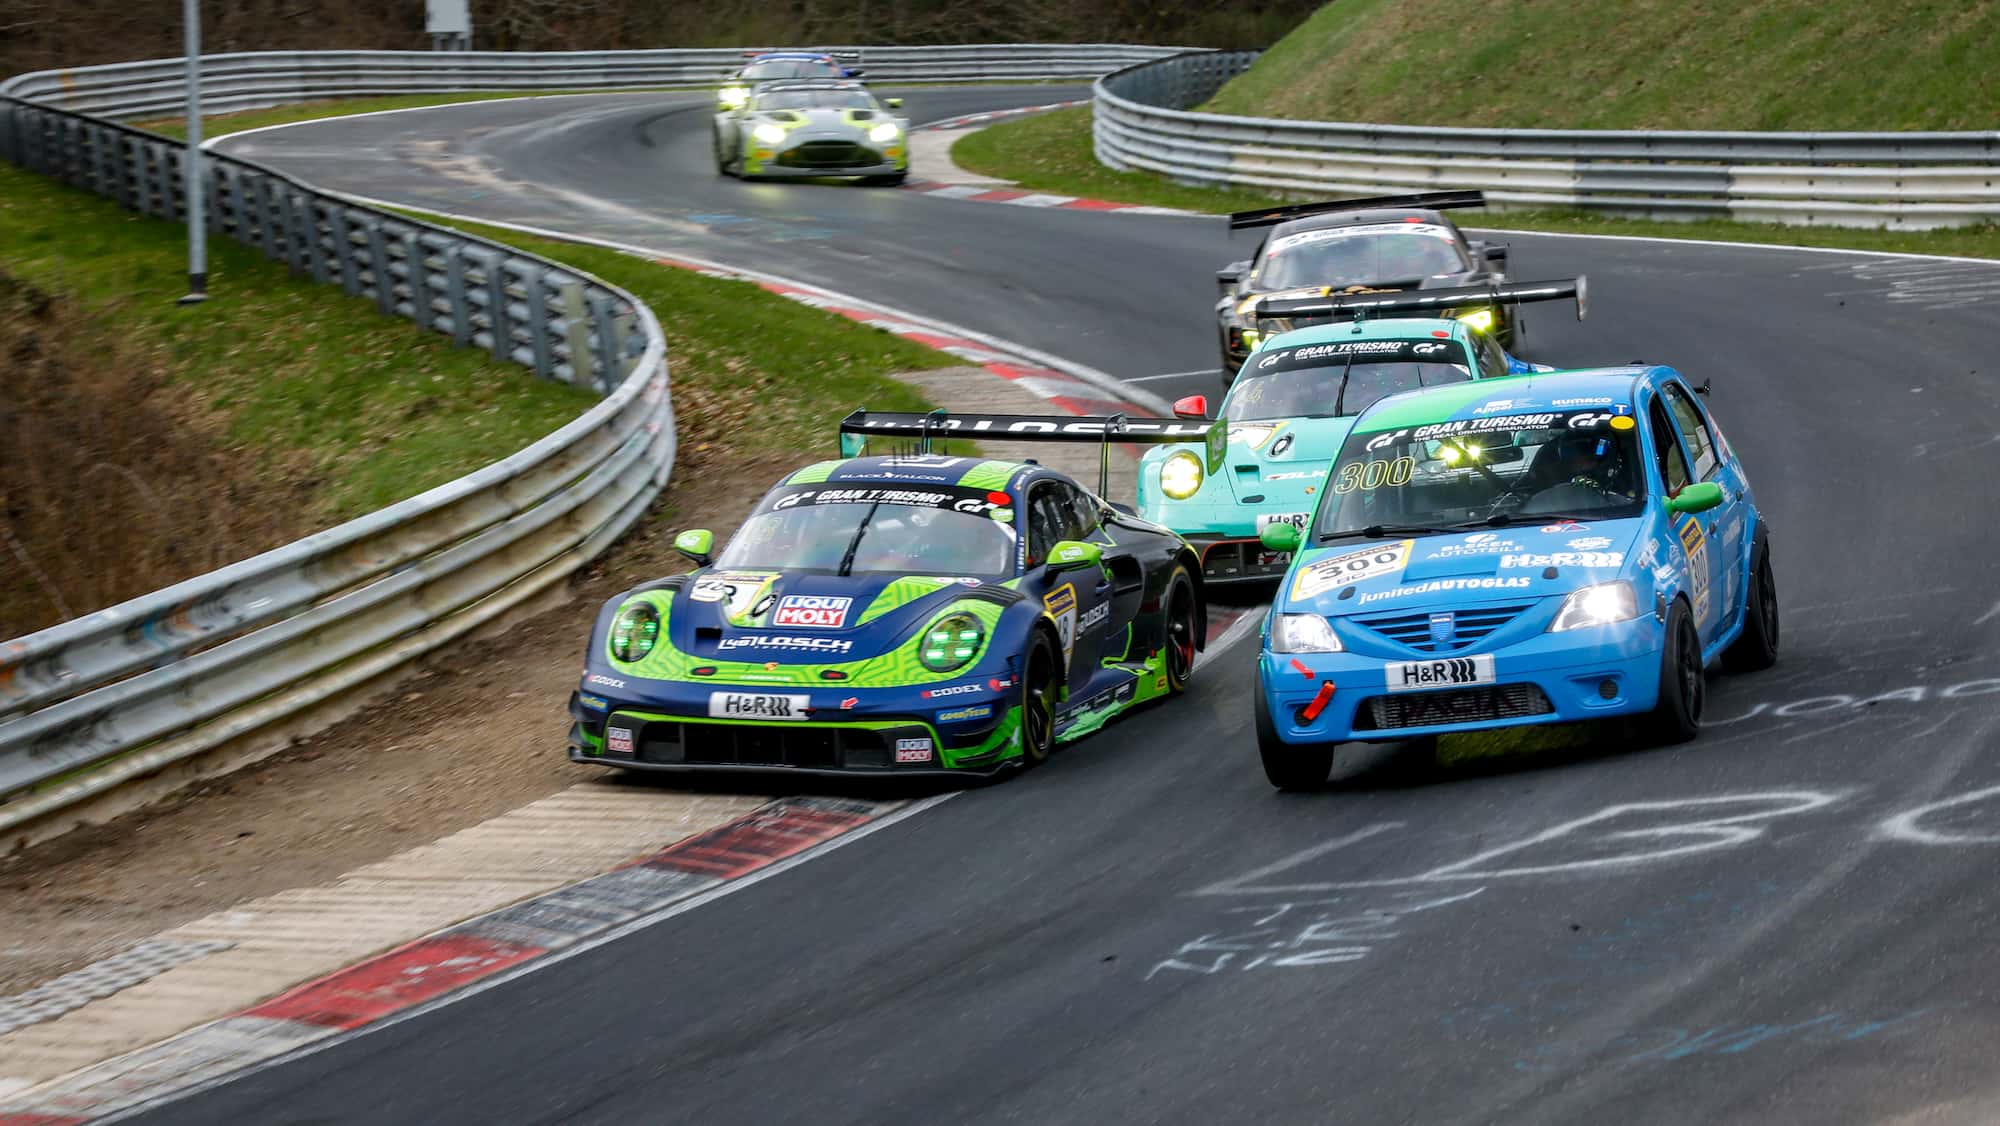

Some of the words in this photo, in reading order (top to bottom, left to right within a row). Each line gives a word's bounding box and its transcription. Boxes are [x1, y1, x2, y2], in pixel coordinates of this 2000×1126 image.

[1295, 345, 1336, 357] GRAN
[1614, 404, 1627, 414] T
[1414, 420, 1467, 437] GRAN
[1470, 414, 1554, 430] TURISMO
[1414, 435, 1432, 443] THE
[1432, 432, 1456, 440] REAL
[1458, 428, 1495, 436] DRIVING
[1497, 424, 1549, 432] SIMULATOR
[894, 474, 946, 482] FALCON
[1335, 456, 1415, 494] 300
[816, 489, 868, 501] GRAN
[1427, 546, 1524, 559] AUTOTEILE
[1319, 552, 1397, 580] 300
[784, 597, 848, 609] LIQUI
[779, 610, 842, 624] MOLY
[1403, 663, 1448, 685] H&R
[592, 676, 626, 688] CODEX
[931, 684, 983, 698] CODEX
[725, 695, 768, 713] H&R
